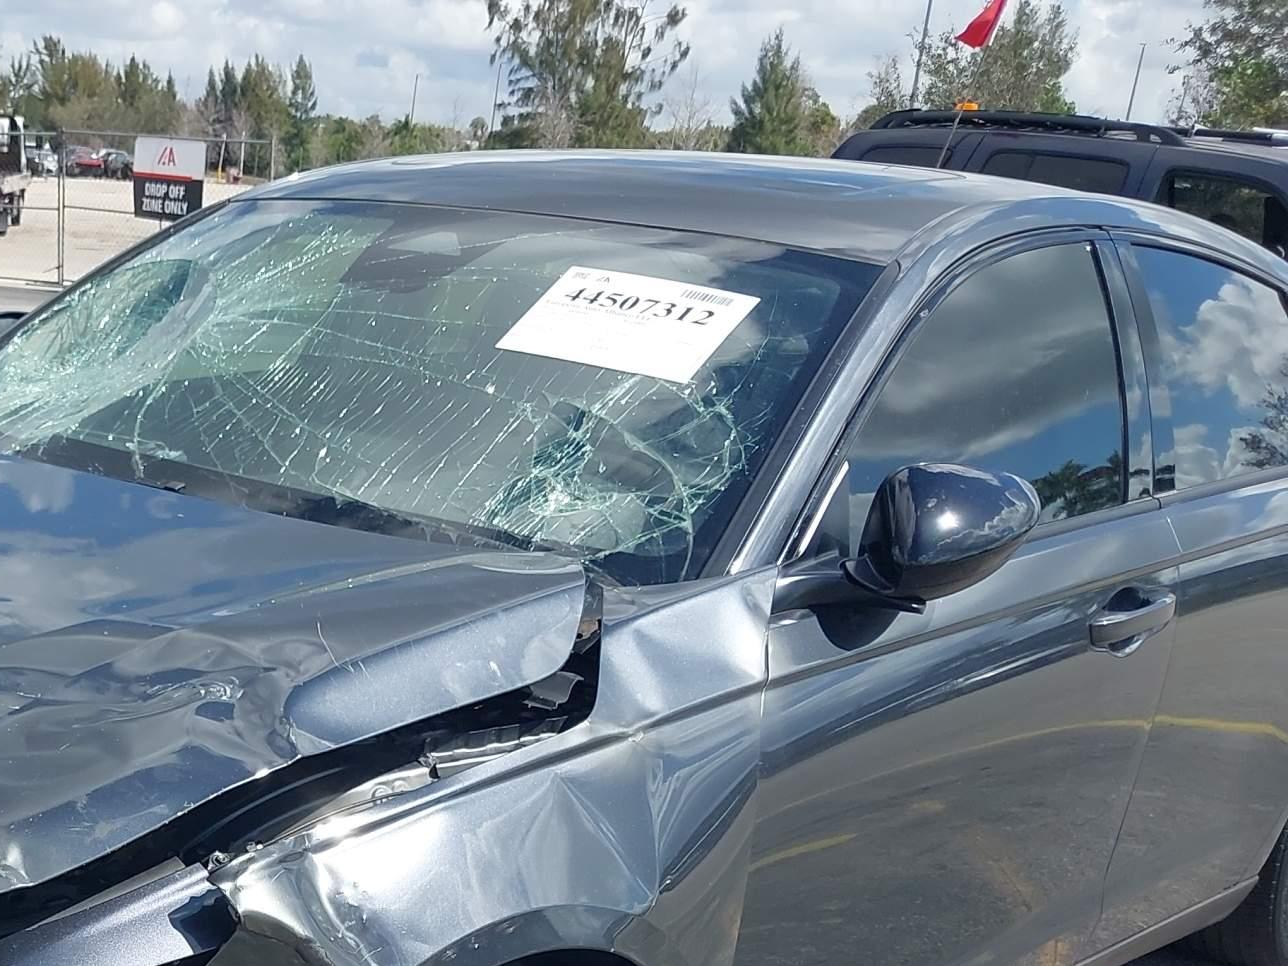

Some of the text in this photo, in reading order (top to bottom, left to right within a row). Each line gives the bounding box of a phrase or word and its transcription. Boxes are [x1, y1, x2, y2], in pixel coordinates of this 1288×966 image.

[144, 183, 186, 199] DROP OFF
[142, 197, 188, 215] ZONE ONLY
[565, 287, 715, 326] 44507312
